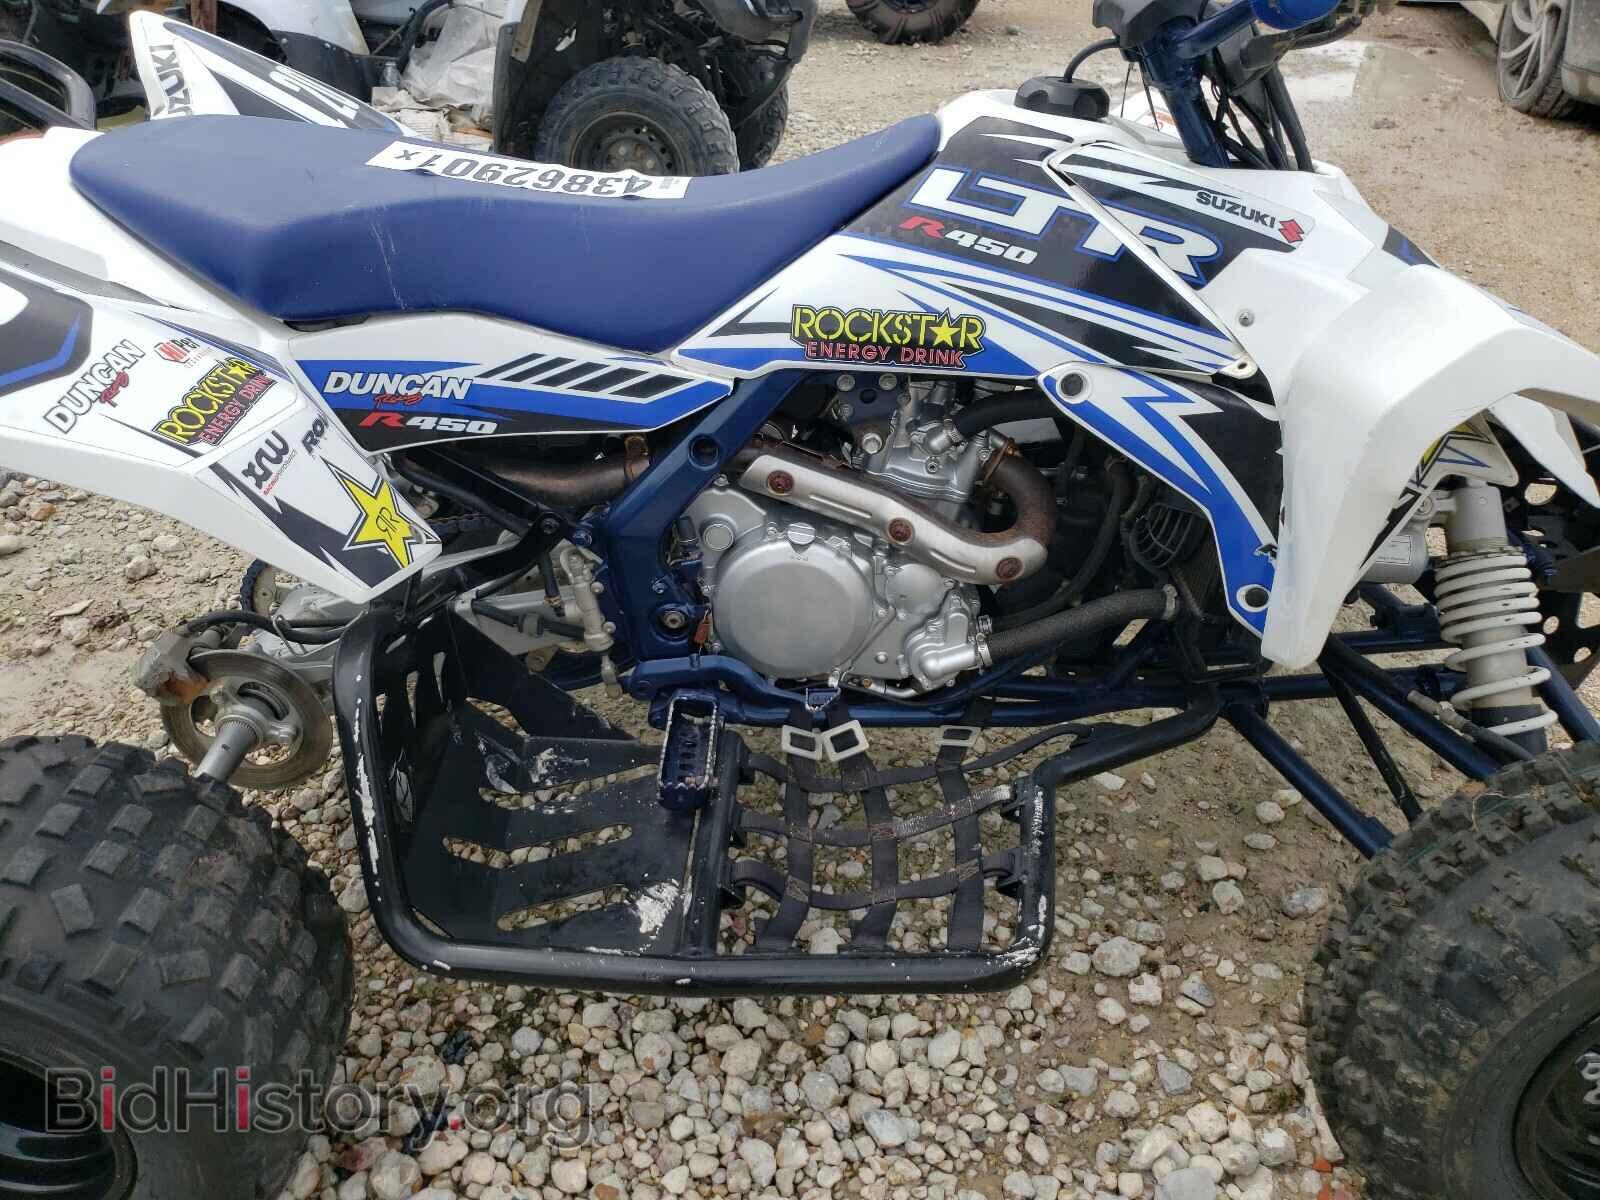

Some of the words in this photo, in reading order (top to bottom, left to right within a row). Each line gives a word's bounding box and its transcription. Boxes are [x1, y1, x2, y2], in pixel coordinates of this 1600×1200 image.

[905, 164, 1223, 287] LTR
[1195, 190, 1275, 229] SUZUKI
[794, 307, 983, 349] ROCKSTAR
[806, 341, 890, 361] ENERGY
[901, 346, 964, 368] DRINK
[43, 339, 146, 434] DUNCAN
[324, 371, 473, 400] DUNCAN
[199, 398, 246, 444] ENERGY
